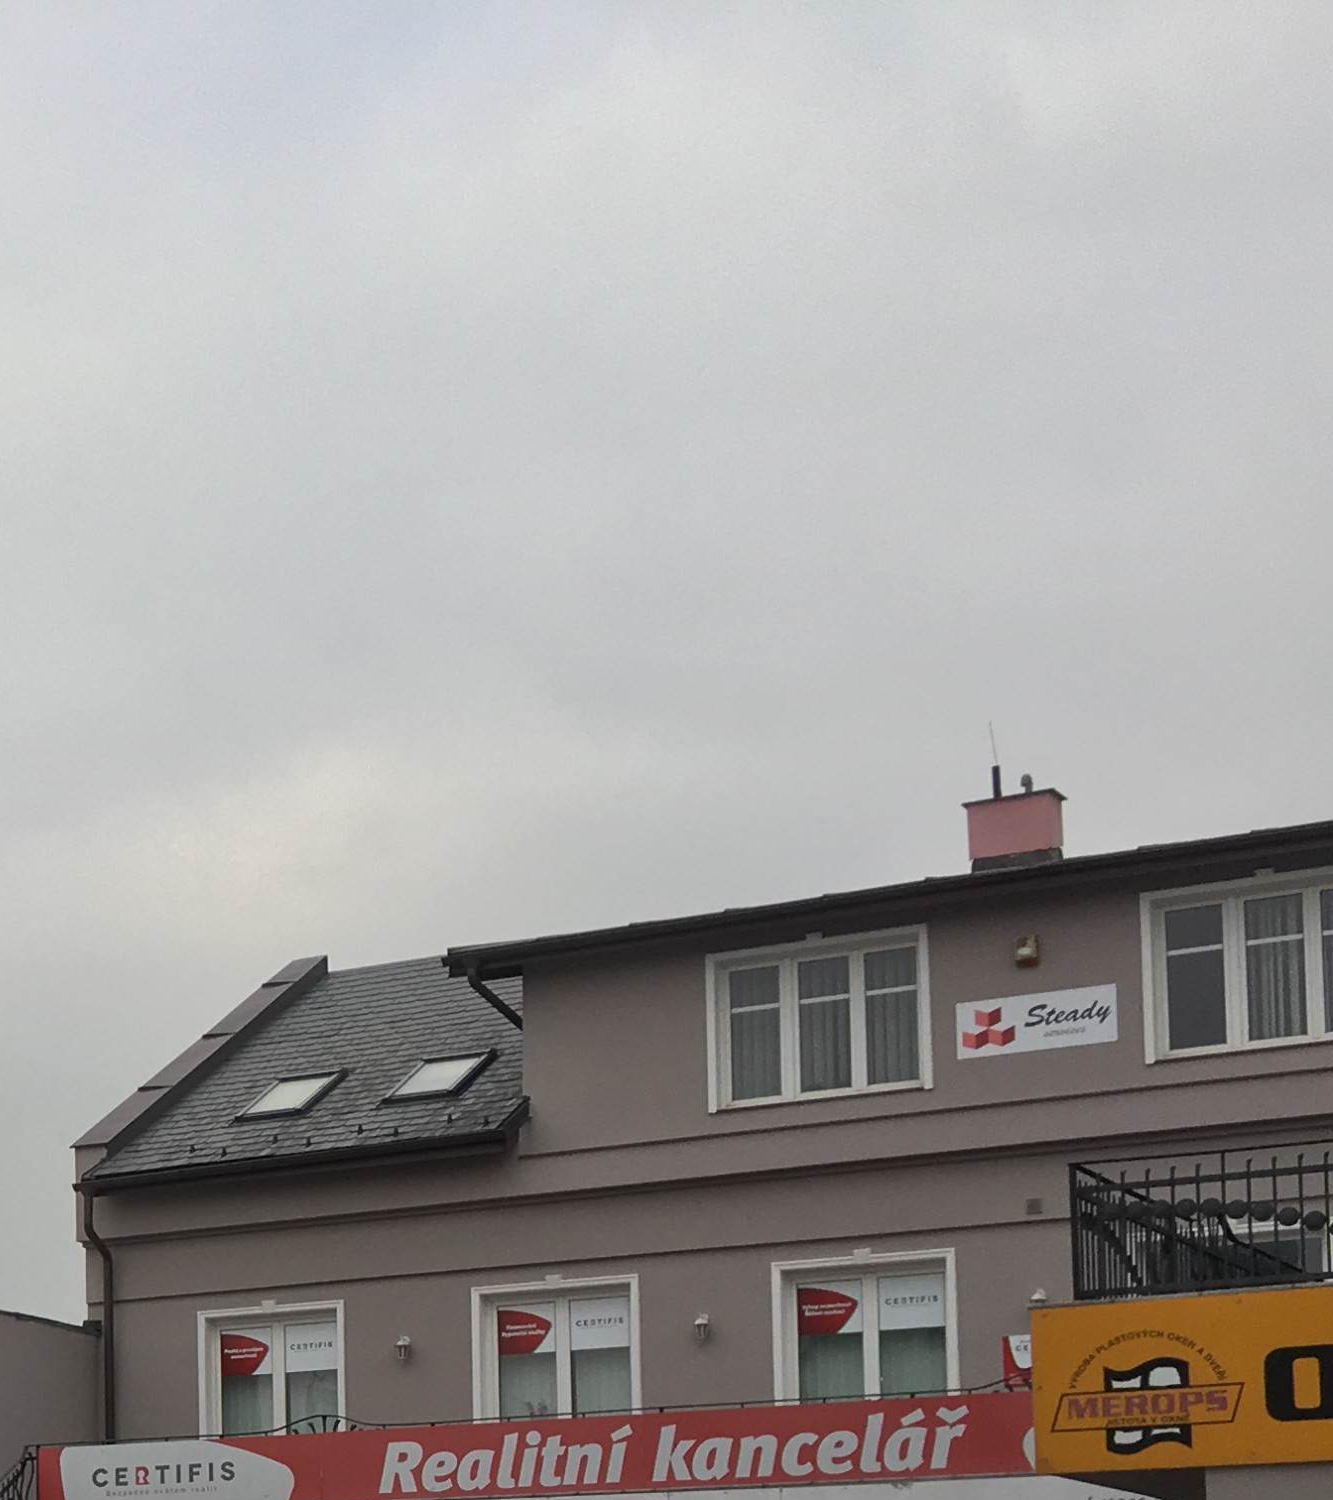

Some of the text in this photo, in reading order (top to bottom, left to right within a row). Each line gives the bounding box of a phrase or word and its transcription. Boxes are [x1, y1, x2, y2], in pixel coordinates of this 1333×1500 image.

[1024, 1000, 1112, 1027] Steady
[1067, 1390, 1228, 1420] MEROPS
[378, 1406, 970, 1494] Realitní kancelář
[92, 1461, 236, 1488] CERTIFIS
